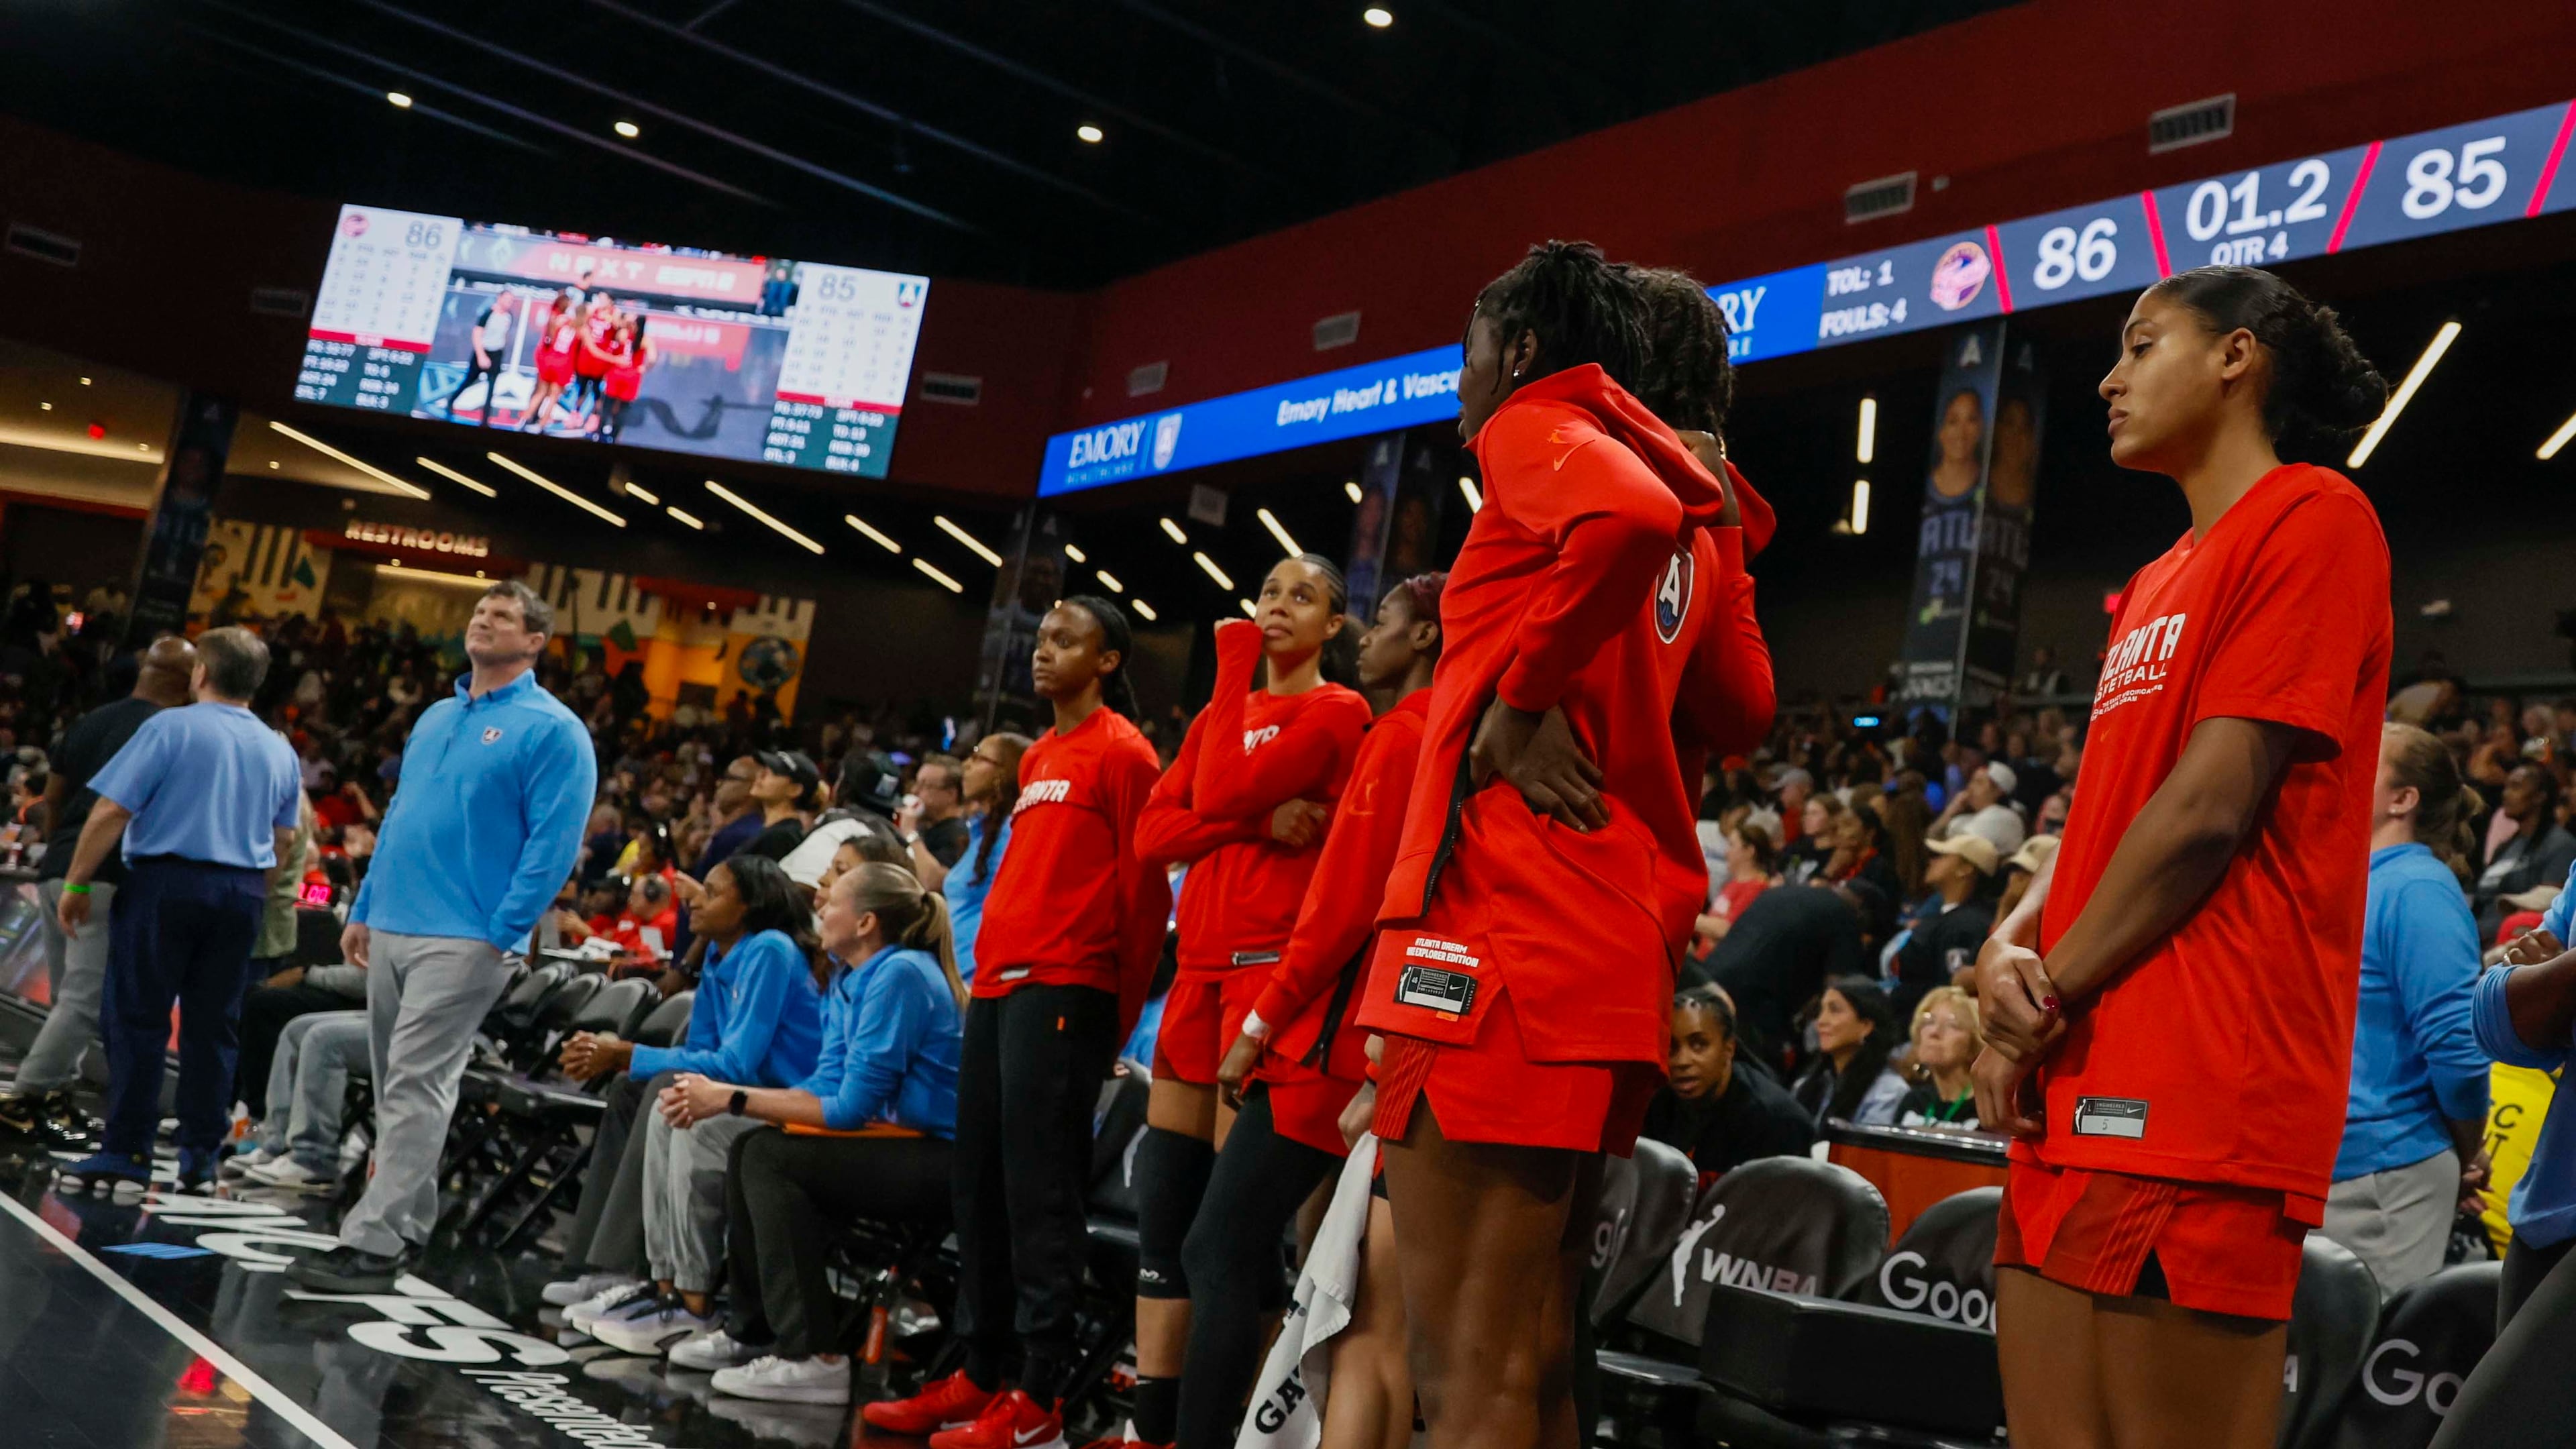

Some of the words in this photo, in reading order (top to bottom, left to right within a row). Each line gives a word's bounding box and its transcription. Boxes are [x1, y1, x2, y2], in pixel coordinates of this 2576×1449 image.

[2186, 158, 2330, 242] 01.2
[2401, 136, 2508, 220] 85
[405, 221, 444, 251] 86
[2033, 217, 2118, 290] 86
[2267, 230, 2289, 260] 4
[818, 272, 857, 303] 85
[1827, 266, 1872, 297] TOL:
[1878, 260, 1894, 287] 1
[1819, 302, 1890, 338] FOULS:
[1890, 297, 1908, 323] 4
[1277, 396, 1331, 427] Emory
[1331, 380, 1383, 415] Heart
[1383, 378, 1398, 405] &
[1068, 420, 1146, 469] EMORY
[344, 519, 490, 557] RESTROOMS
[1415, 938, 1440, 950] ATLANTA
[1441, 942, 1468, 954] DREAM
[1446, 953, 1480, 968] EDITION
[1701, 1248, 1818, 1296] WNBA
[1880, 1251, 1996, 1332] Goo
[1255, 1364, 1305, 1434] GA
